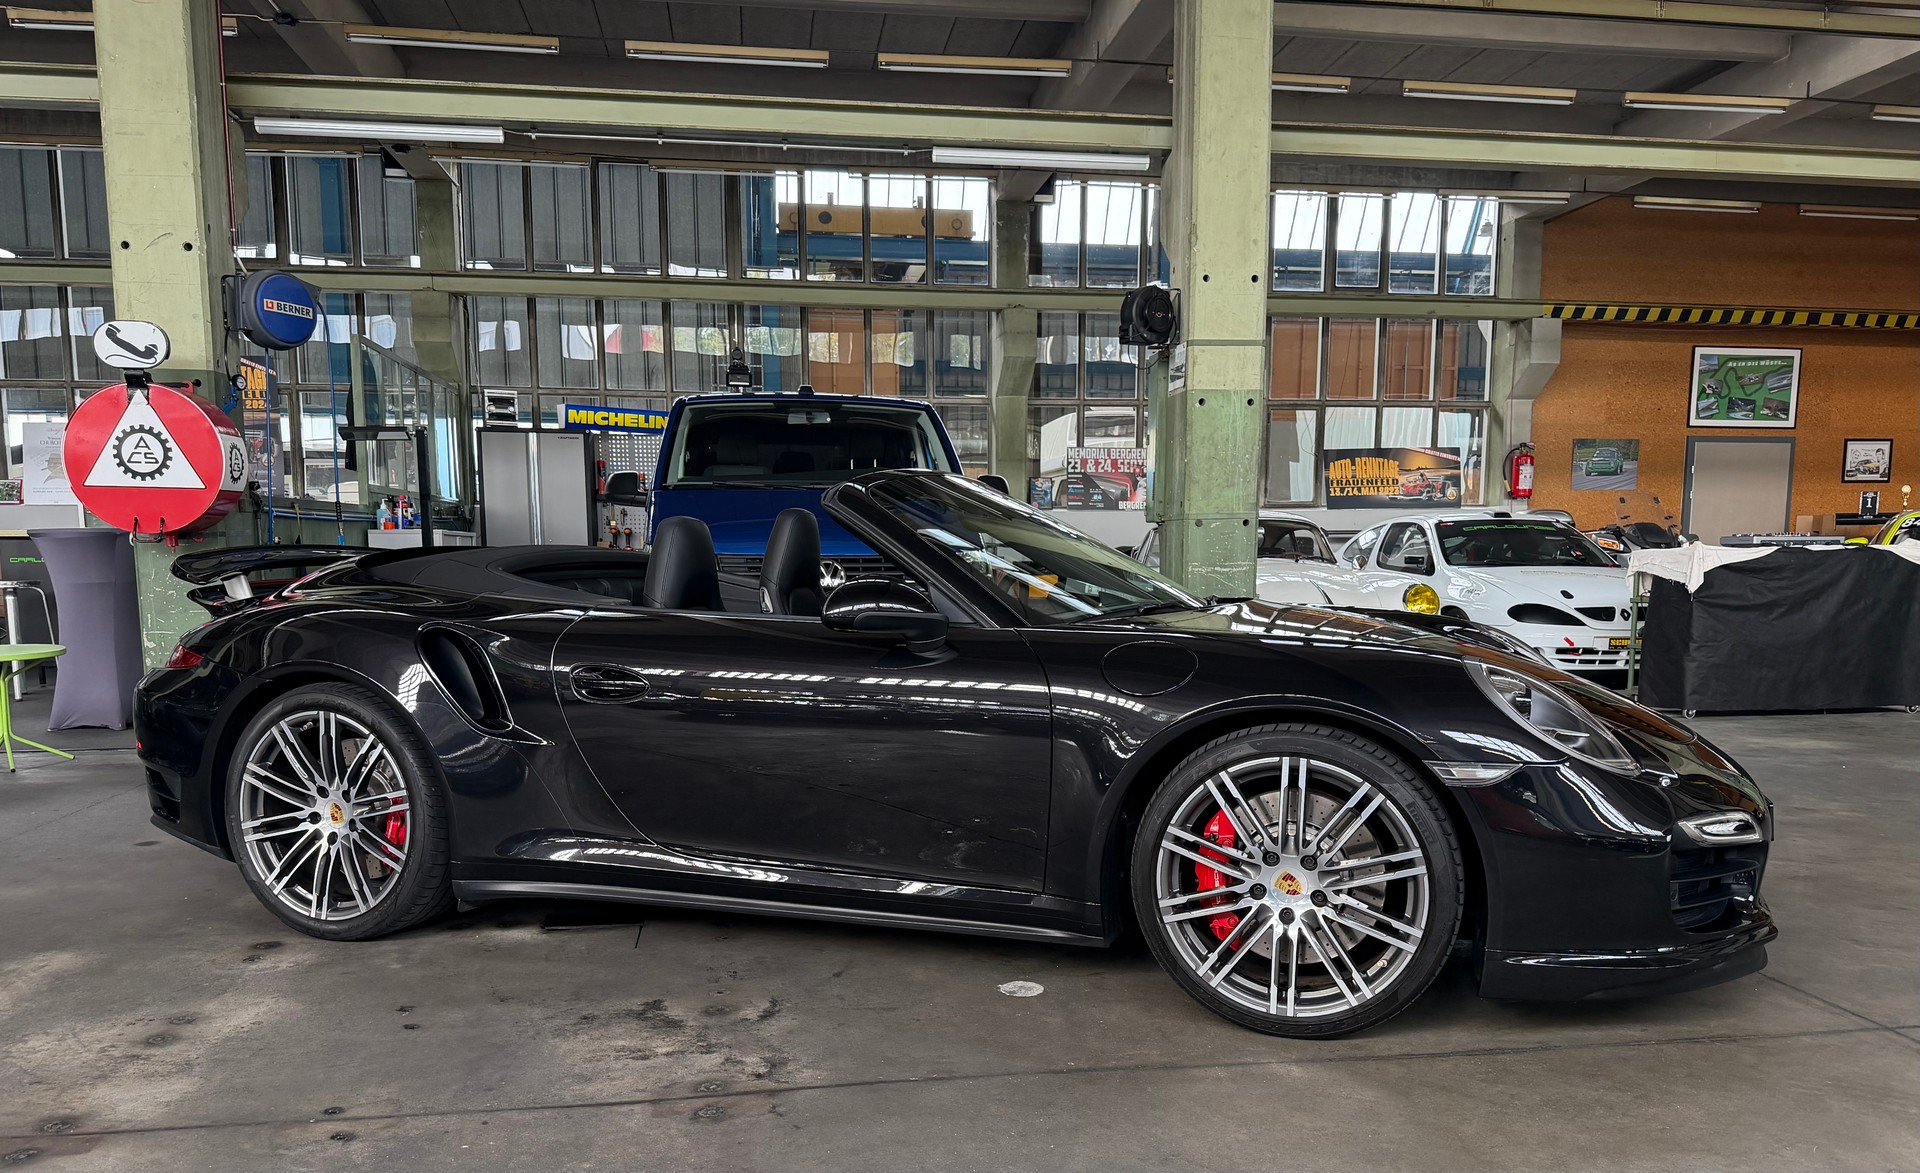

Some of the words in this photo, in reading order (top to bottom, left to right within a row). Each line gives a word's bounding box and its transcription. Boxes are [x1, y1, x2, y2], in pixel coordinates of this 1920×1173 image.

[276, 302, 311, 317] BERNER
[567, 409, 669, 429] MICHELIN
[1068, 448, 1109, 459] MEMORIAL
[1068, 459, 1084, 472] 23.
[1087, 459, 1096, 472] &
[1098, 459, 1115, 472] 24.
[1329, 457, 1400, 479] AUTO-RENNTAGE
[1330, 479, 1399, 487] FRAUENFELD
[1866, 498, 1872, 508] 1
